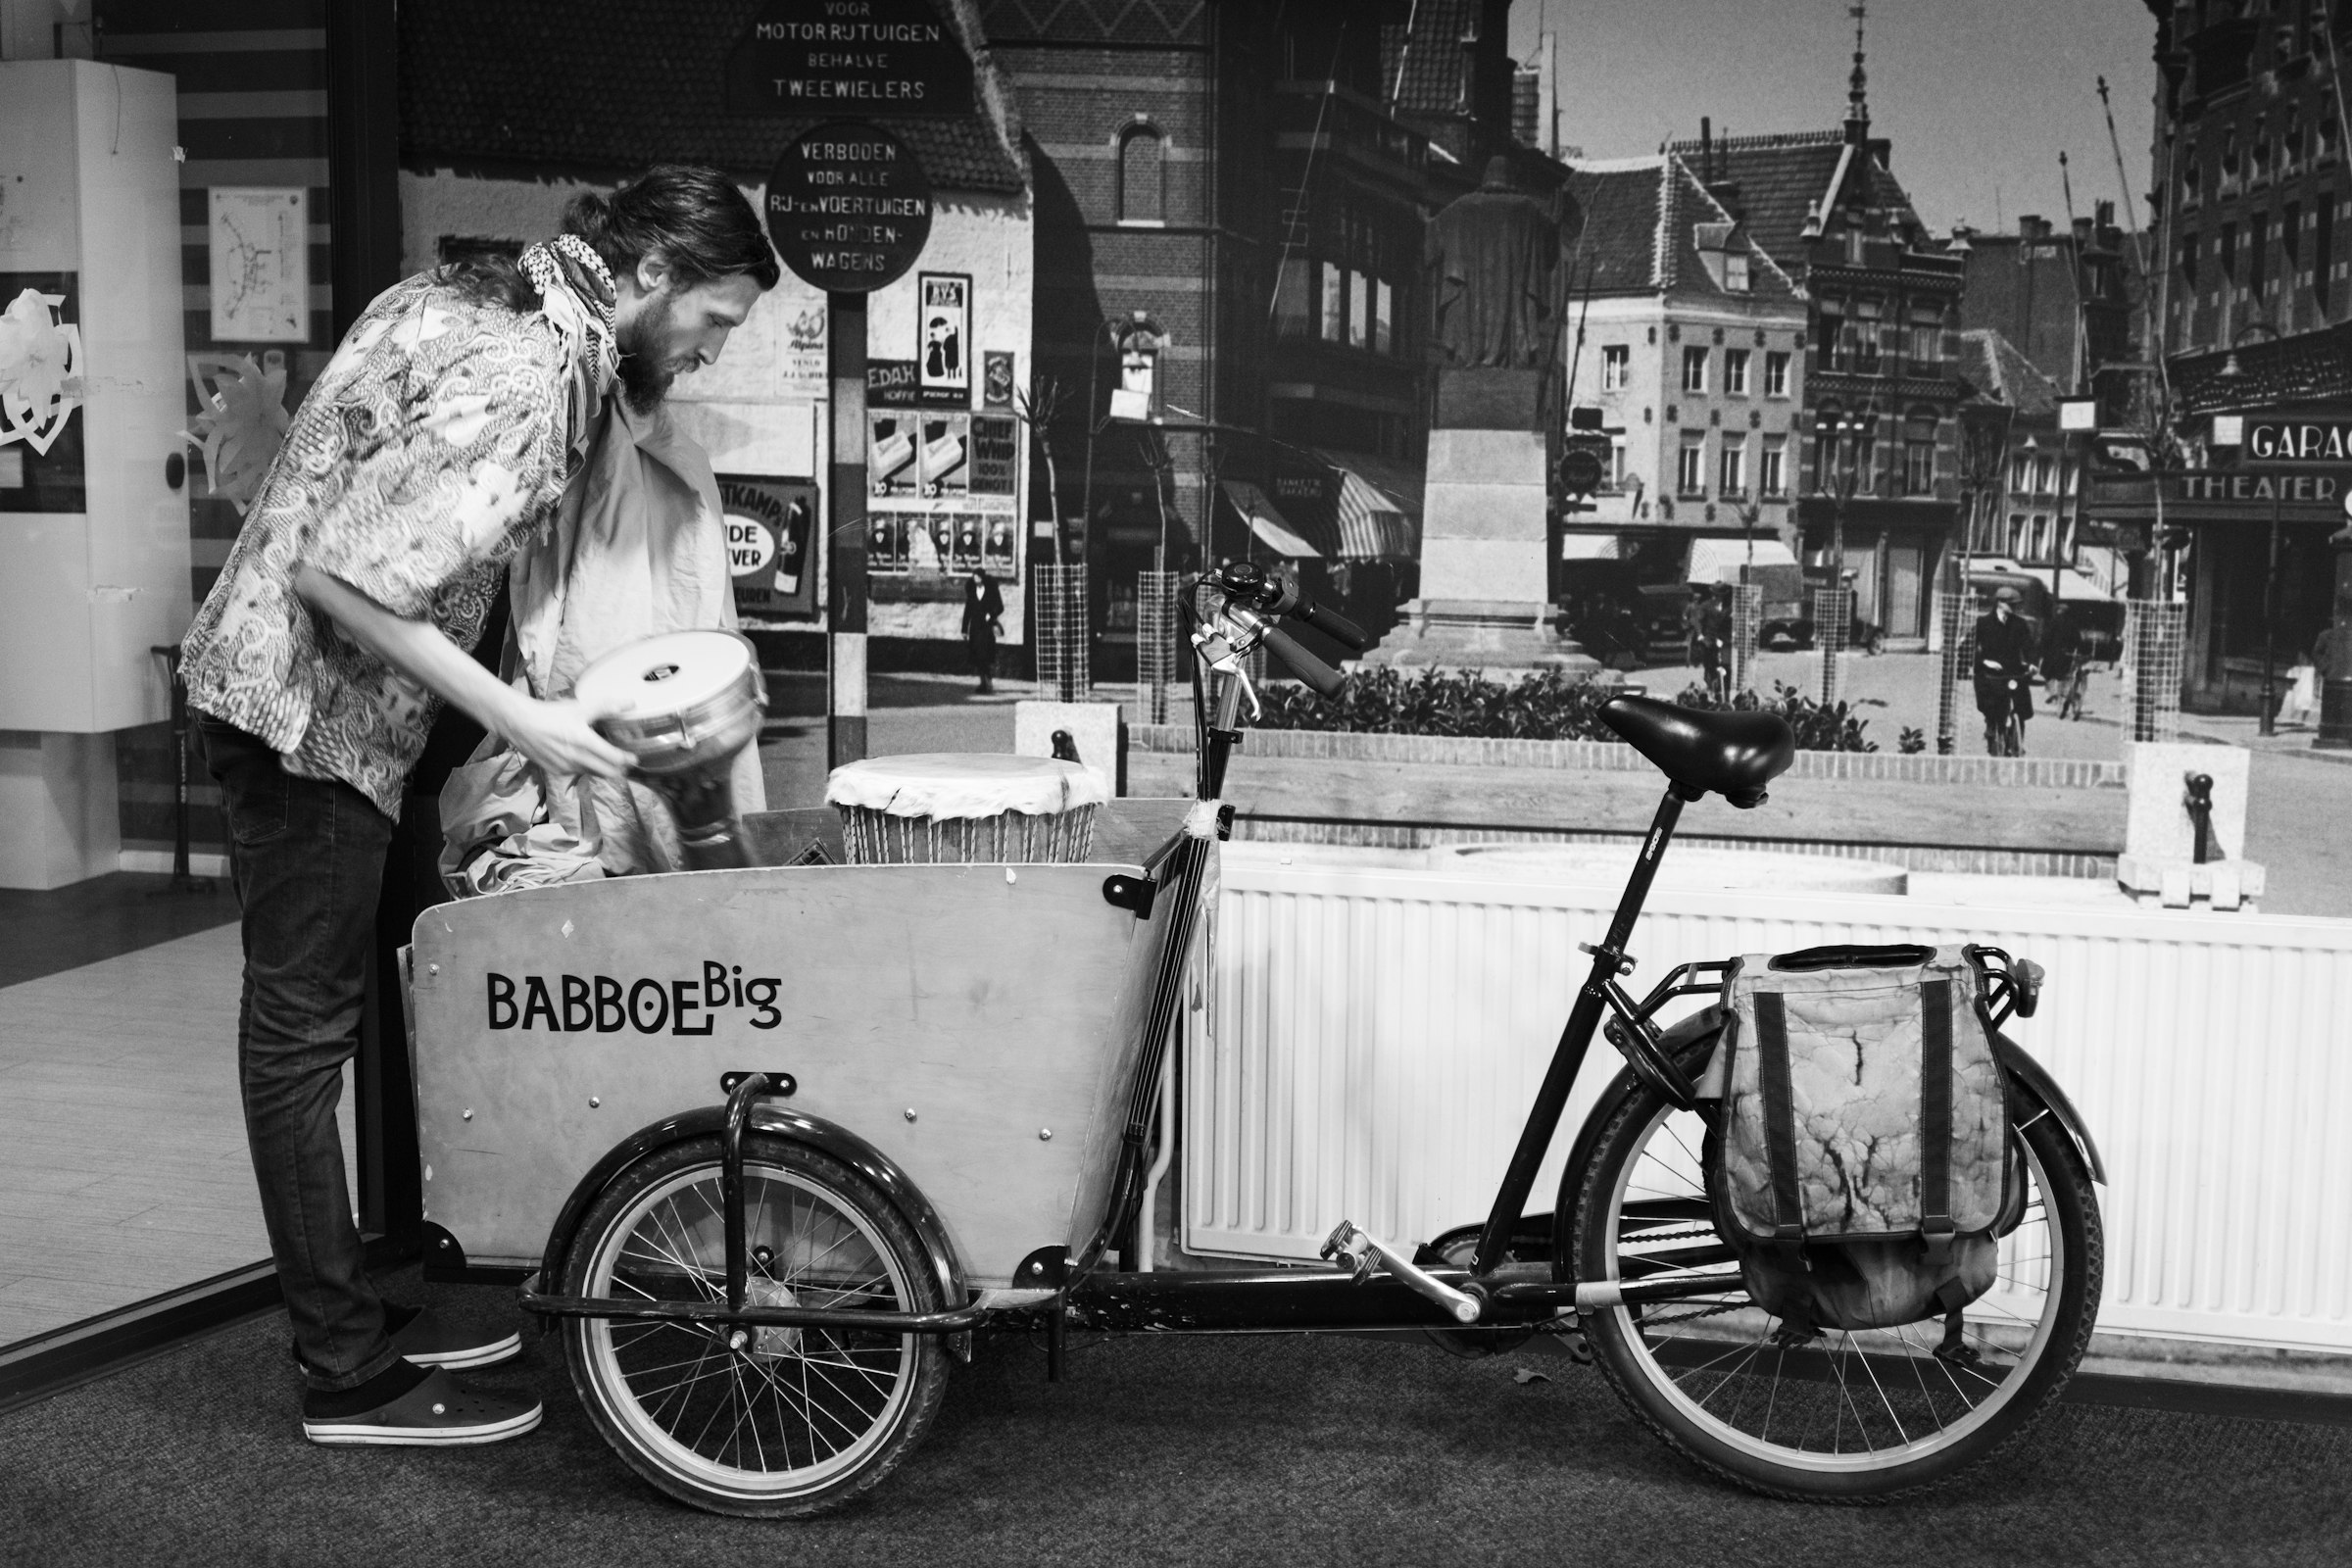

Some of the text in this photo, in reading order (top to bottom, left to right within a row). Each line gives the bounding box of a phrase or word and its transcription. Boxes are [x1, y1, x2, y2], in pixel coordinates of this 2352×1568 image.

[825, 1, 871, 17] VOOR
[808, 53, 889, 69] BEHALVE
[772, 78, 925, 99] TWEEWIELERS
[801, 142, 896, 162] VERBODEN
[807, 172, 889, 187] VOOR ALLE
[819, 195, 926, 217] VOERTUIGEN
[811, 251, 886, 271] WAGENS
[2252, 425, 2352, 458] GARA
[2182, 476, 2336, 501] THEATER
[725, 525, 758, 543] DE
[730, 550, 761, 566] VER
[487, 960, 782, 1036] BABBOE Big
